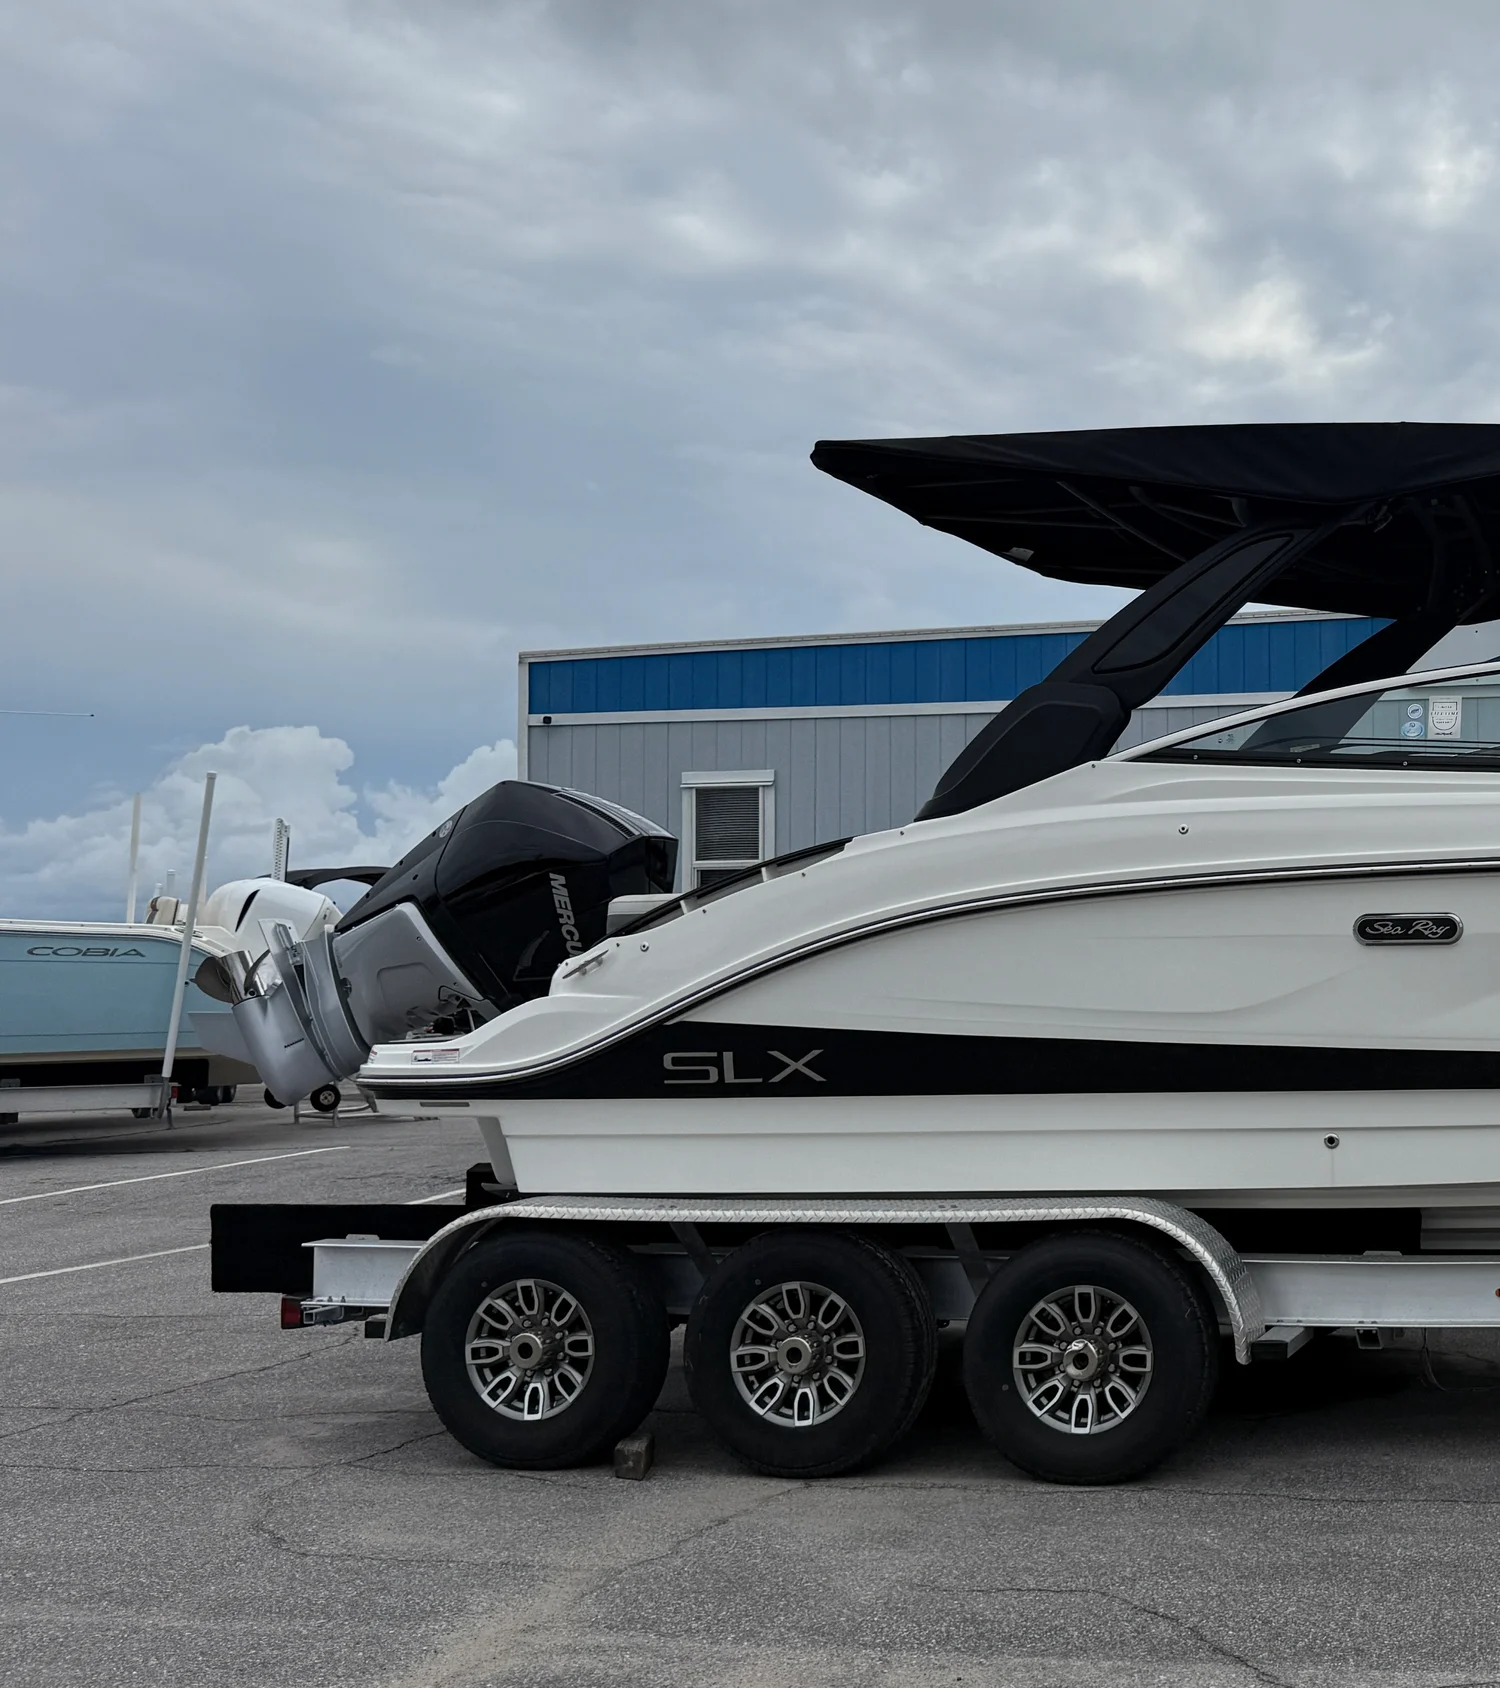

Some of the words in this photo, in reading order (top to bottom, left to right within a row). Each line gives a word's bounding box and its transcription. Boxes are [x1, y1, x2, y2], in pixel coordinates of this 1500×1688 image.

[549, 872, 585, 958] MERCU
[1365, 921, 1406, 935] Sea
[1408, 920, 1450, 938] Ray
[26, 946, 147, 958] COBIA
[663, 1049, 828, 1084] SLX
